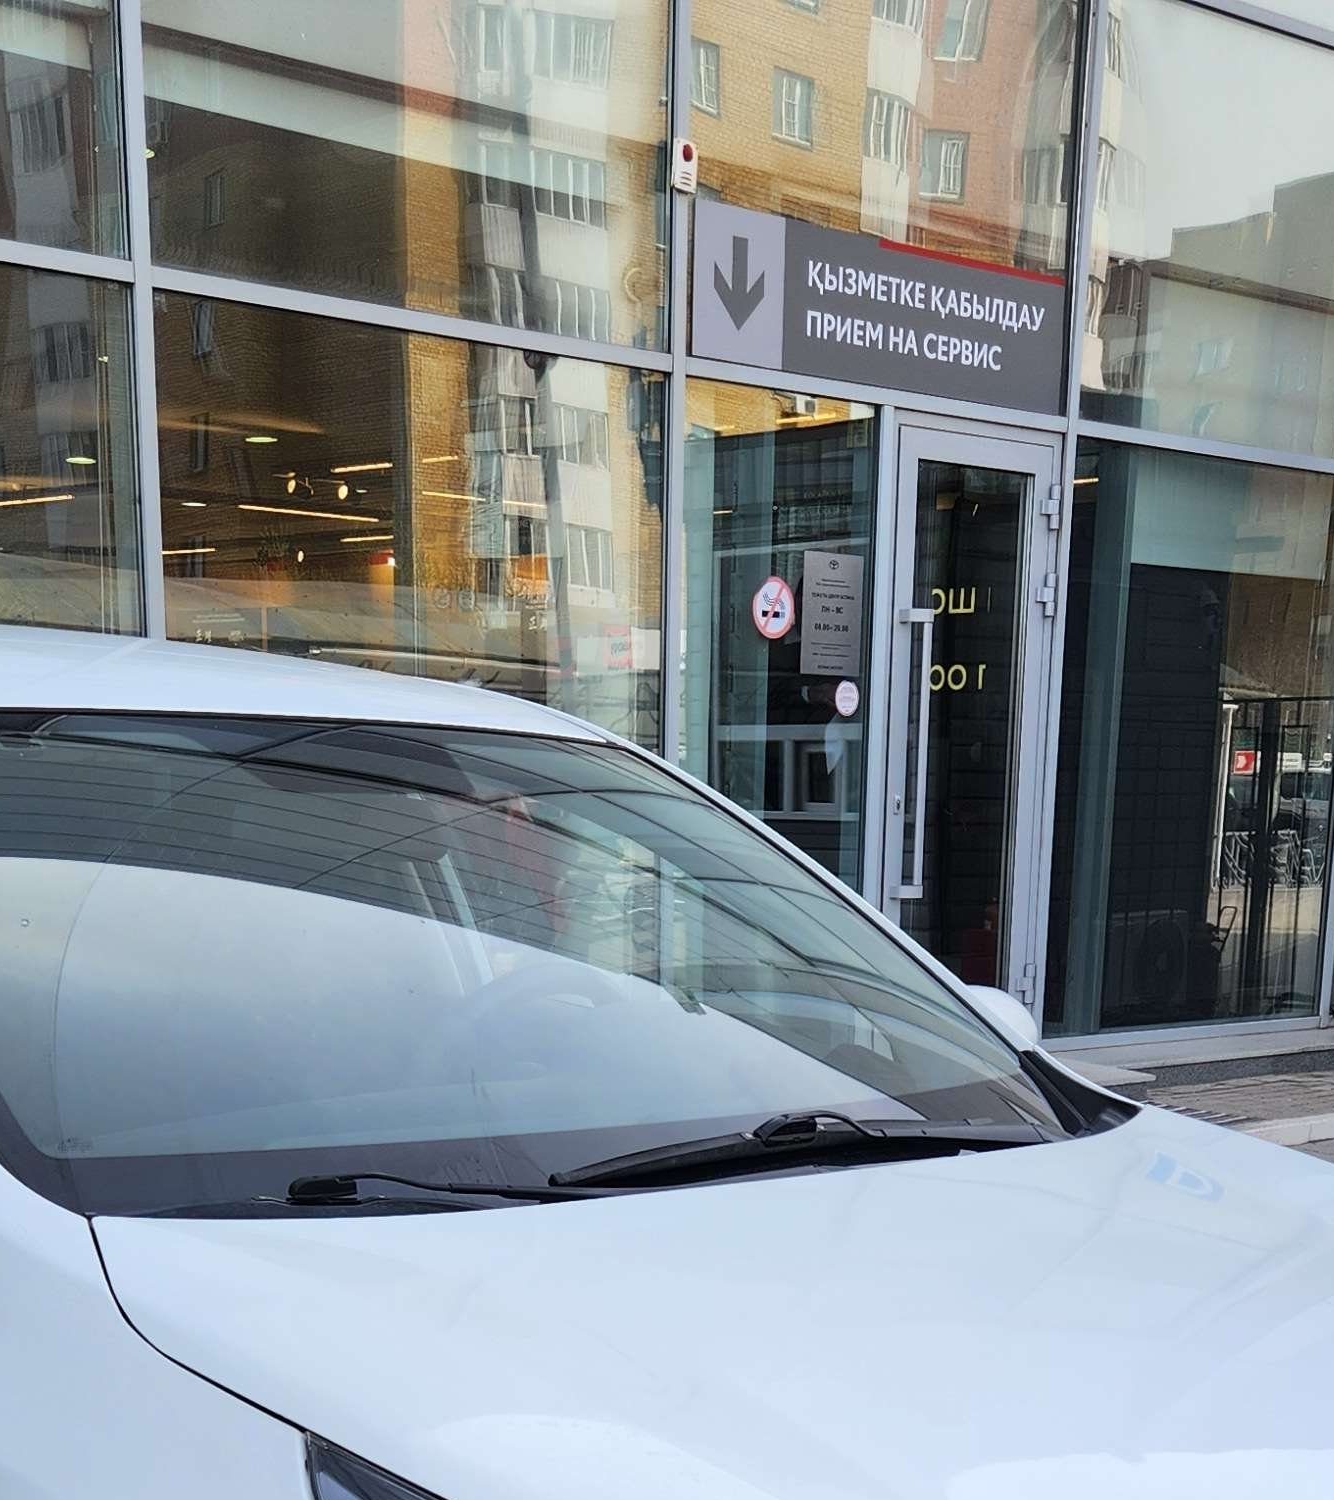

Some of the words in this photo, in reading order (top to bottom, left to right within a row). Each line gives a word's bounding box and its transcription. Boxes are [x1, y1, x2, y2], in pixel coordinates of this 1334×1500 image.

[808, 260, 926, 310] ҚЫЗМЕТКЕ
[931, 285, 1045, 333] ҚАБЫЛДАУ
[806, 310, 884, 350] ПРИЕМ
[889, 326, 918, 356] НА
[923, 332, 1003, 371] СЕРВИС
